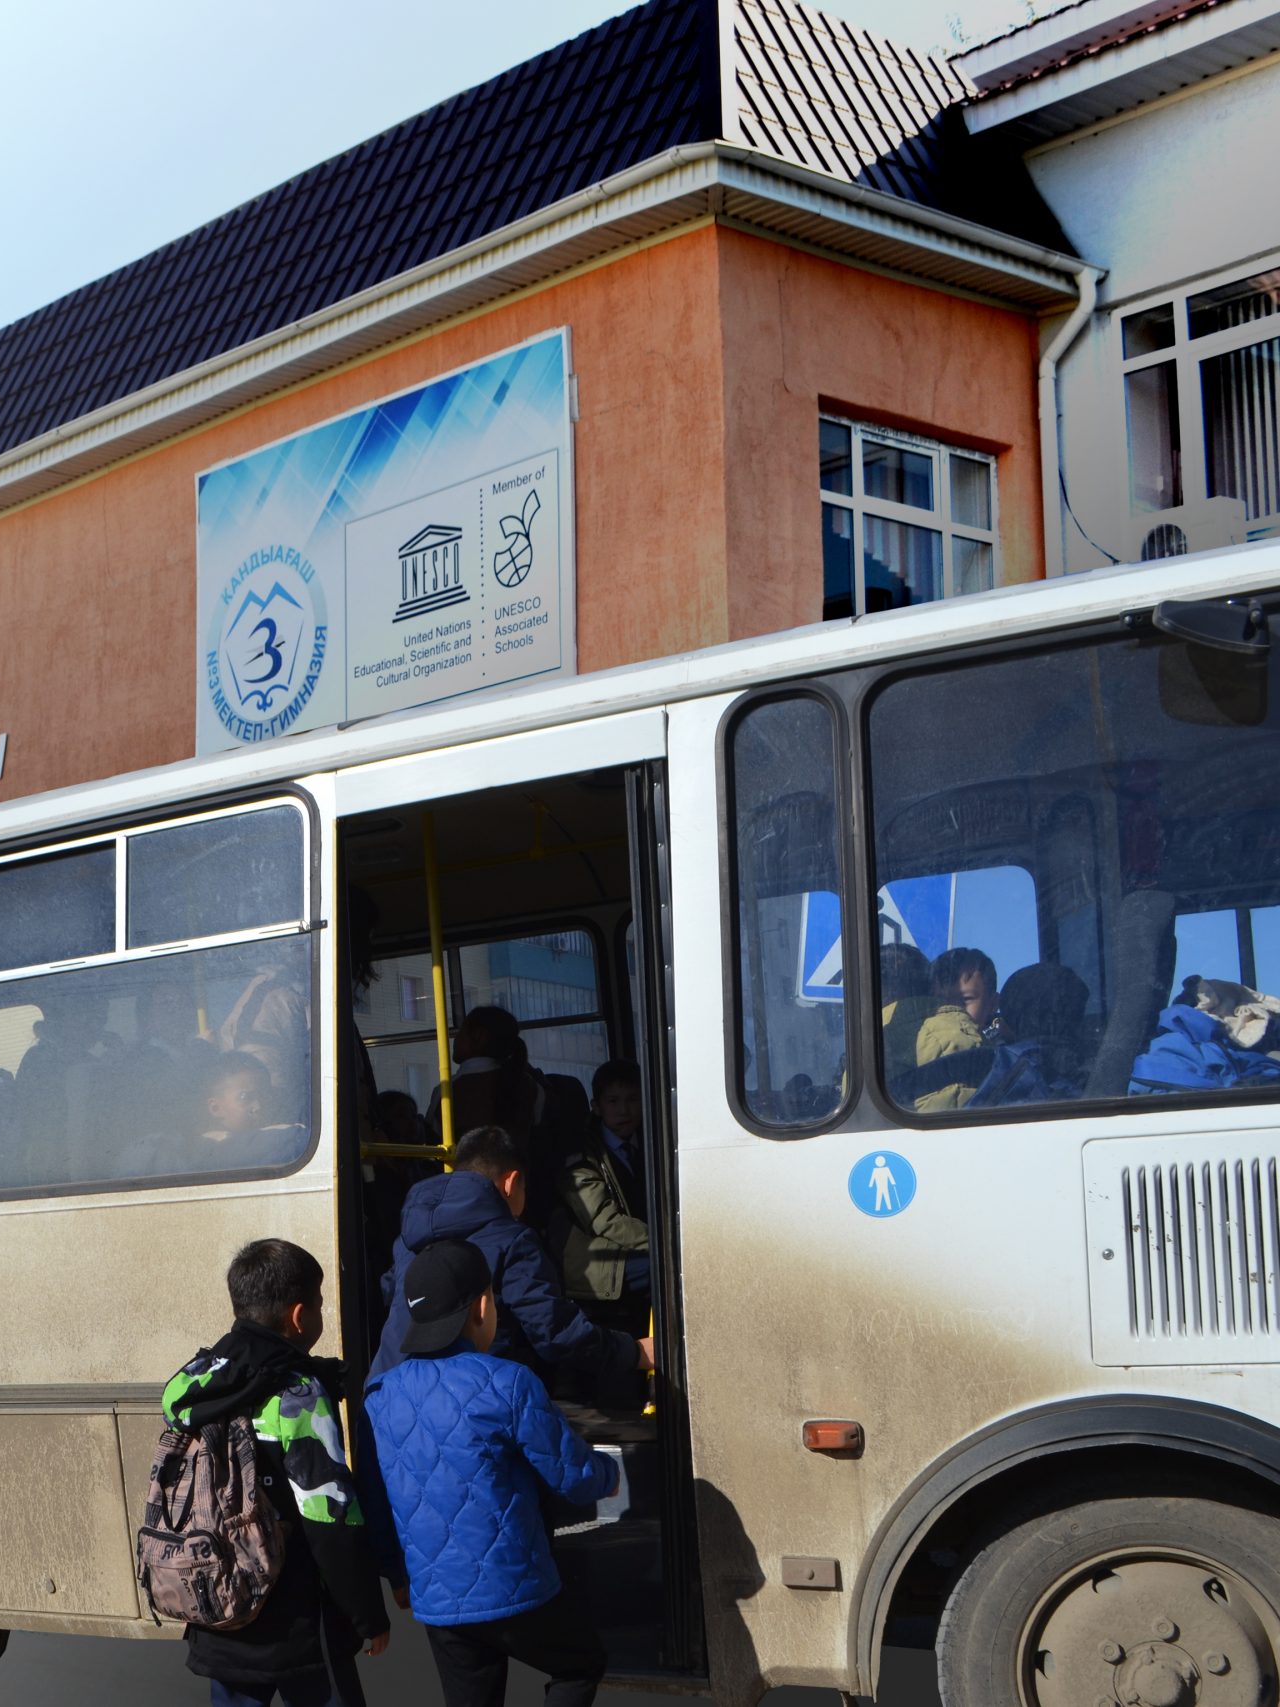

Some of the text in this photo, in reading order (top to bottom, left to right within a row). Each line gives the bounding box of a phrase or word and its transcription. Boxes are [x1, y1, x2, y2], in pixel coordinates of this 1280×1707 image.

[492, 465, 546, 496] Member of
[401, 542, 460, 602] UNESCO
[494, 595, 541, 620] UNESCO
[403, 619, 471, 648] United Nations
[494, 612, 549, 638] Associated
[353, 634, 472, 679] Educational, Scientific and
[494, 634, 534, 655] Schools
[212, 624, 327, 742] МЕКТЕП-ГИМНАЗИЯ
[376, 652, 472, 688] Cultural Organization
